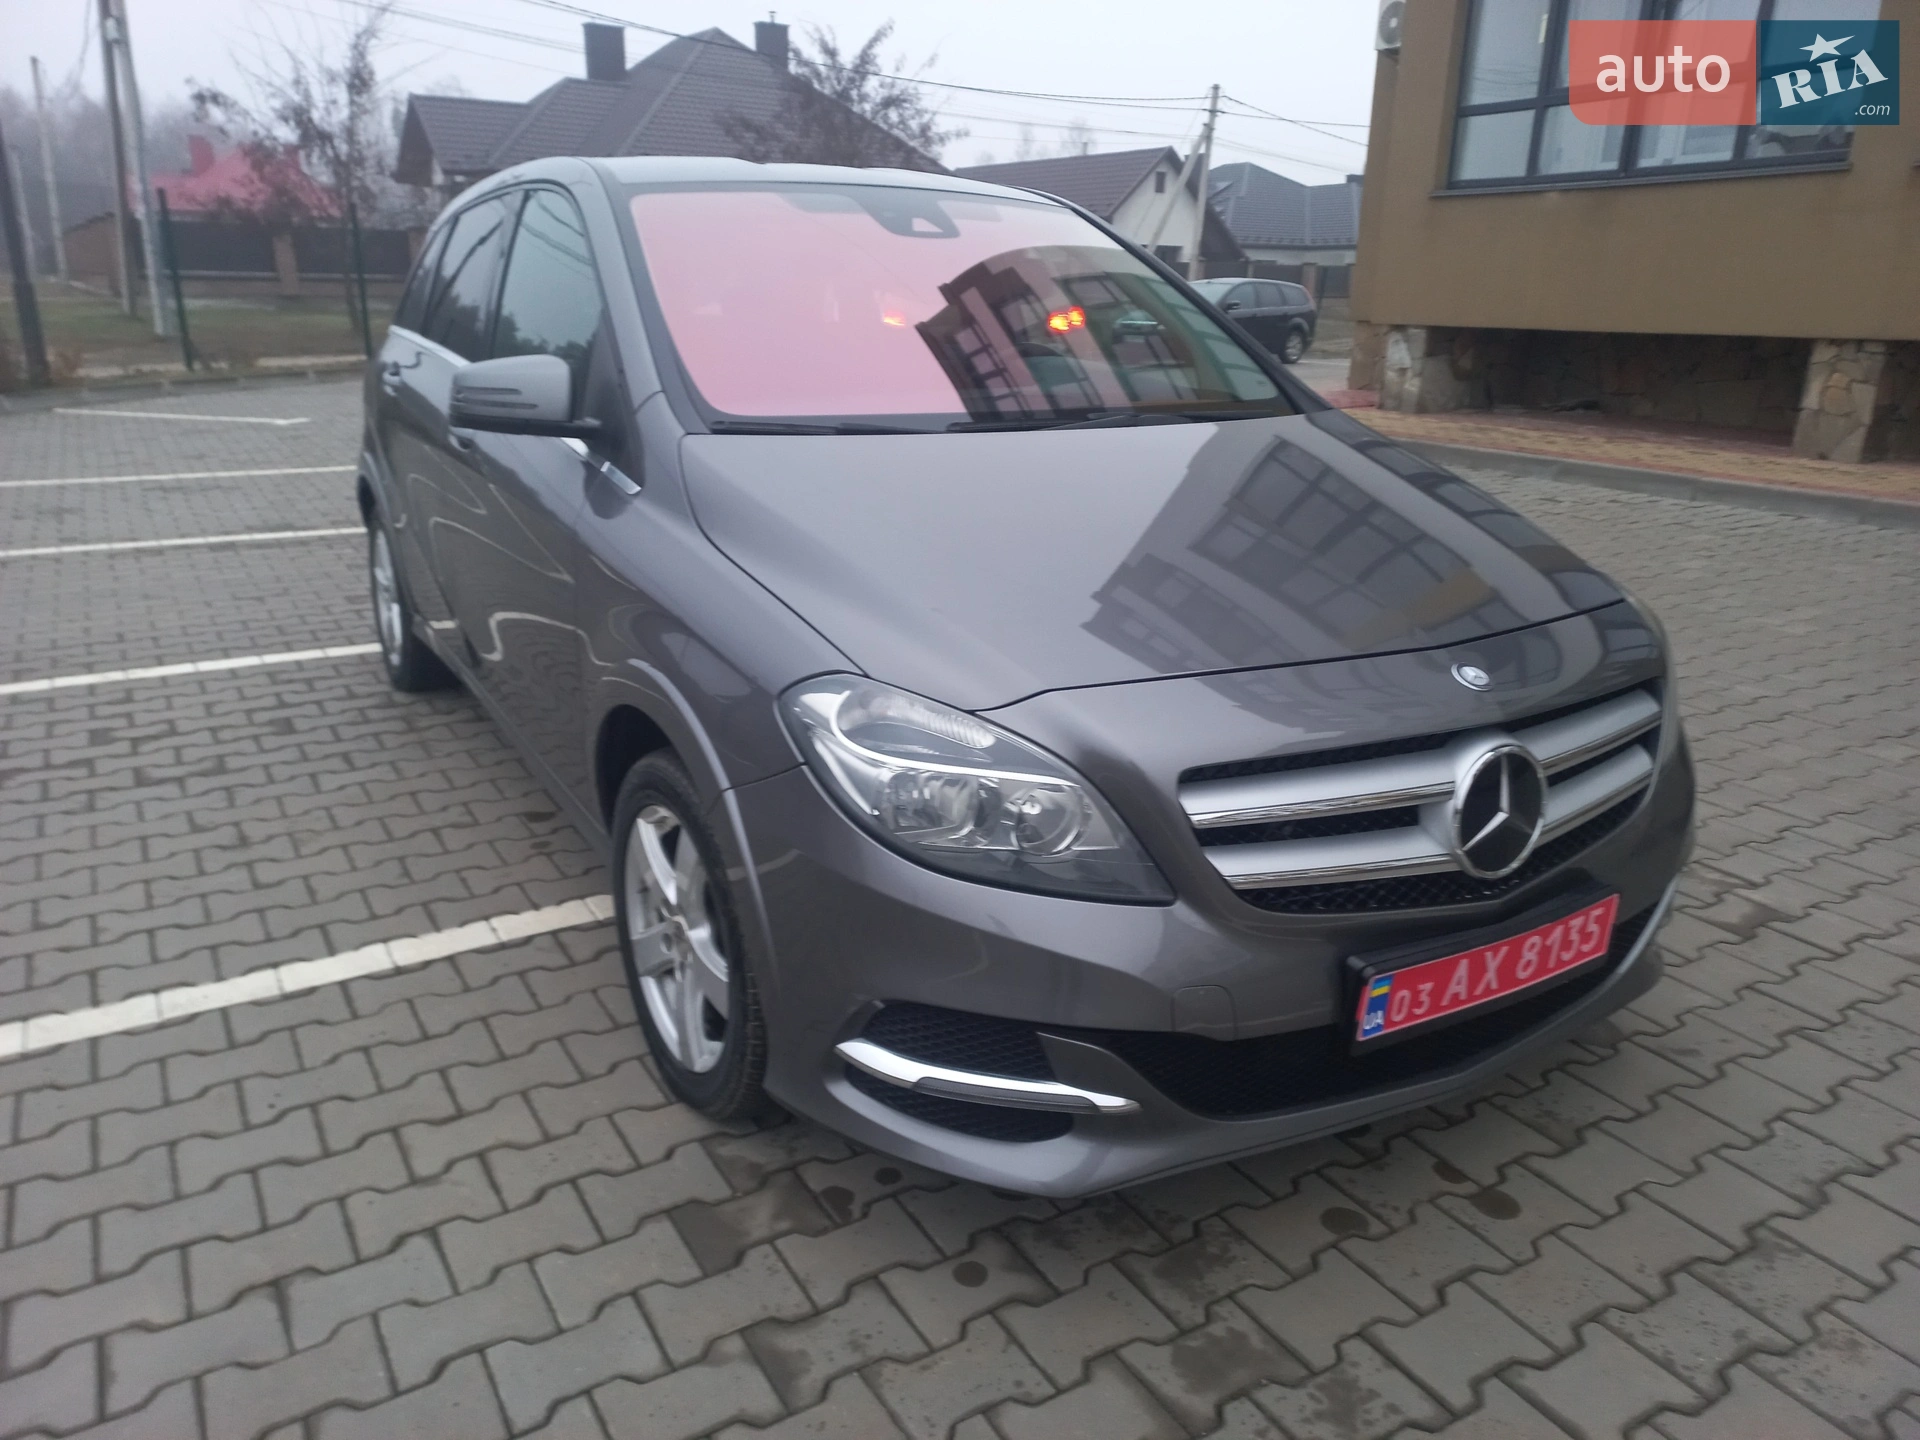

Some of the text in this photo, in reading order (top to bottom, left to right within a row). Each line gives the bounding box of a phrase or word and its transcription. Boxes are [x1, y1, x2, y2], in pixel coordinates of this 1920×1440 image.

[1390, 907, 1605, 1022] 03 AX 8135
[1363, 1010, 1384, 1030] UA
